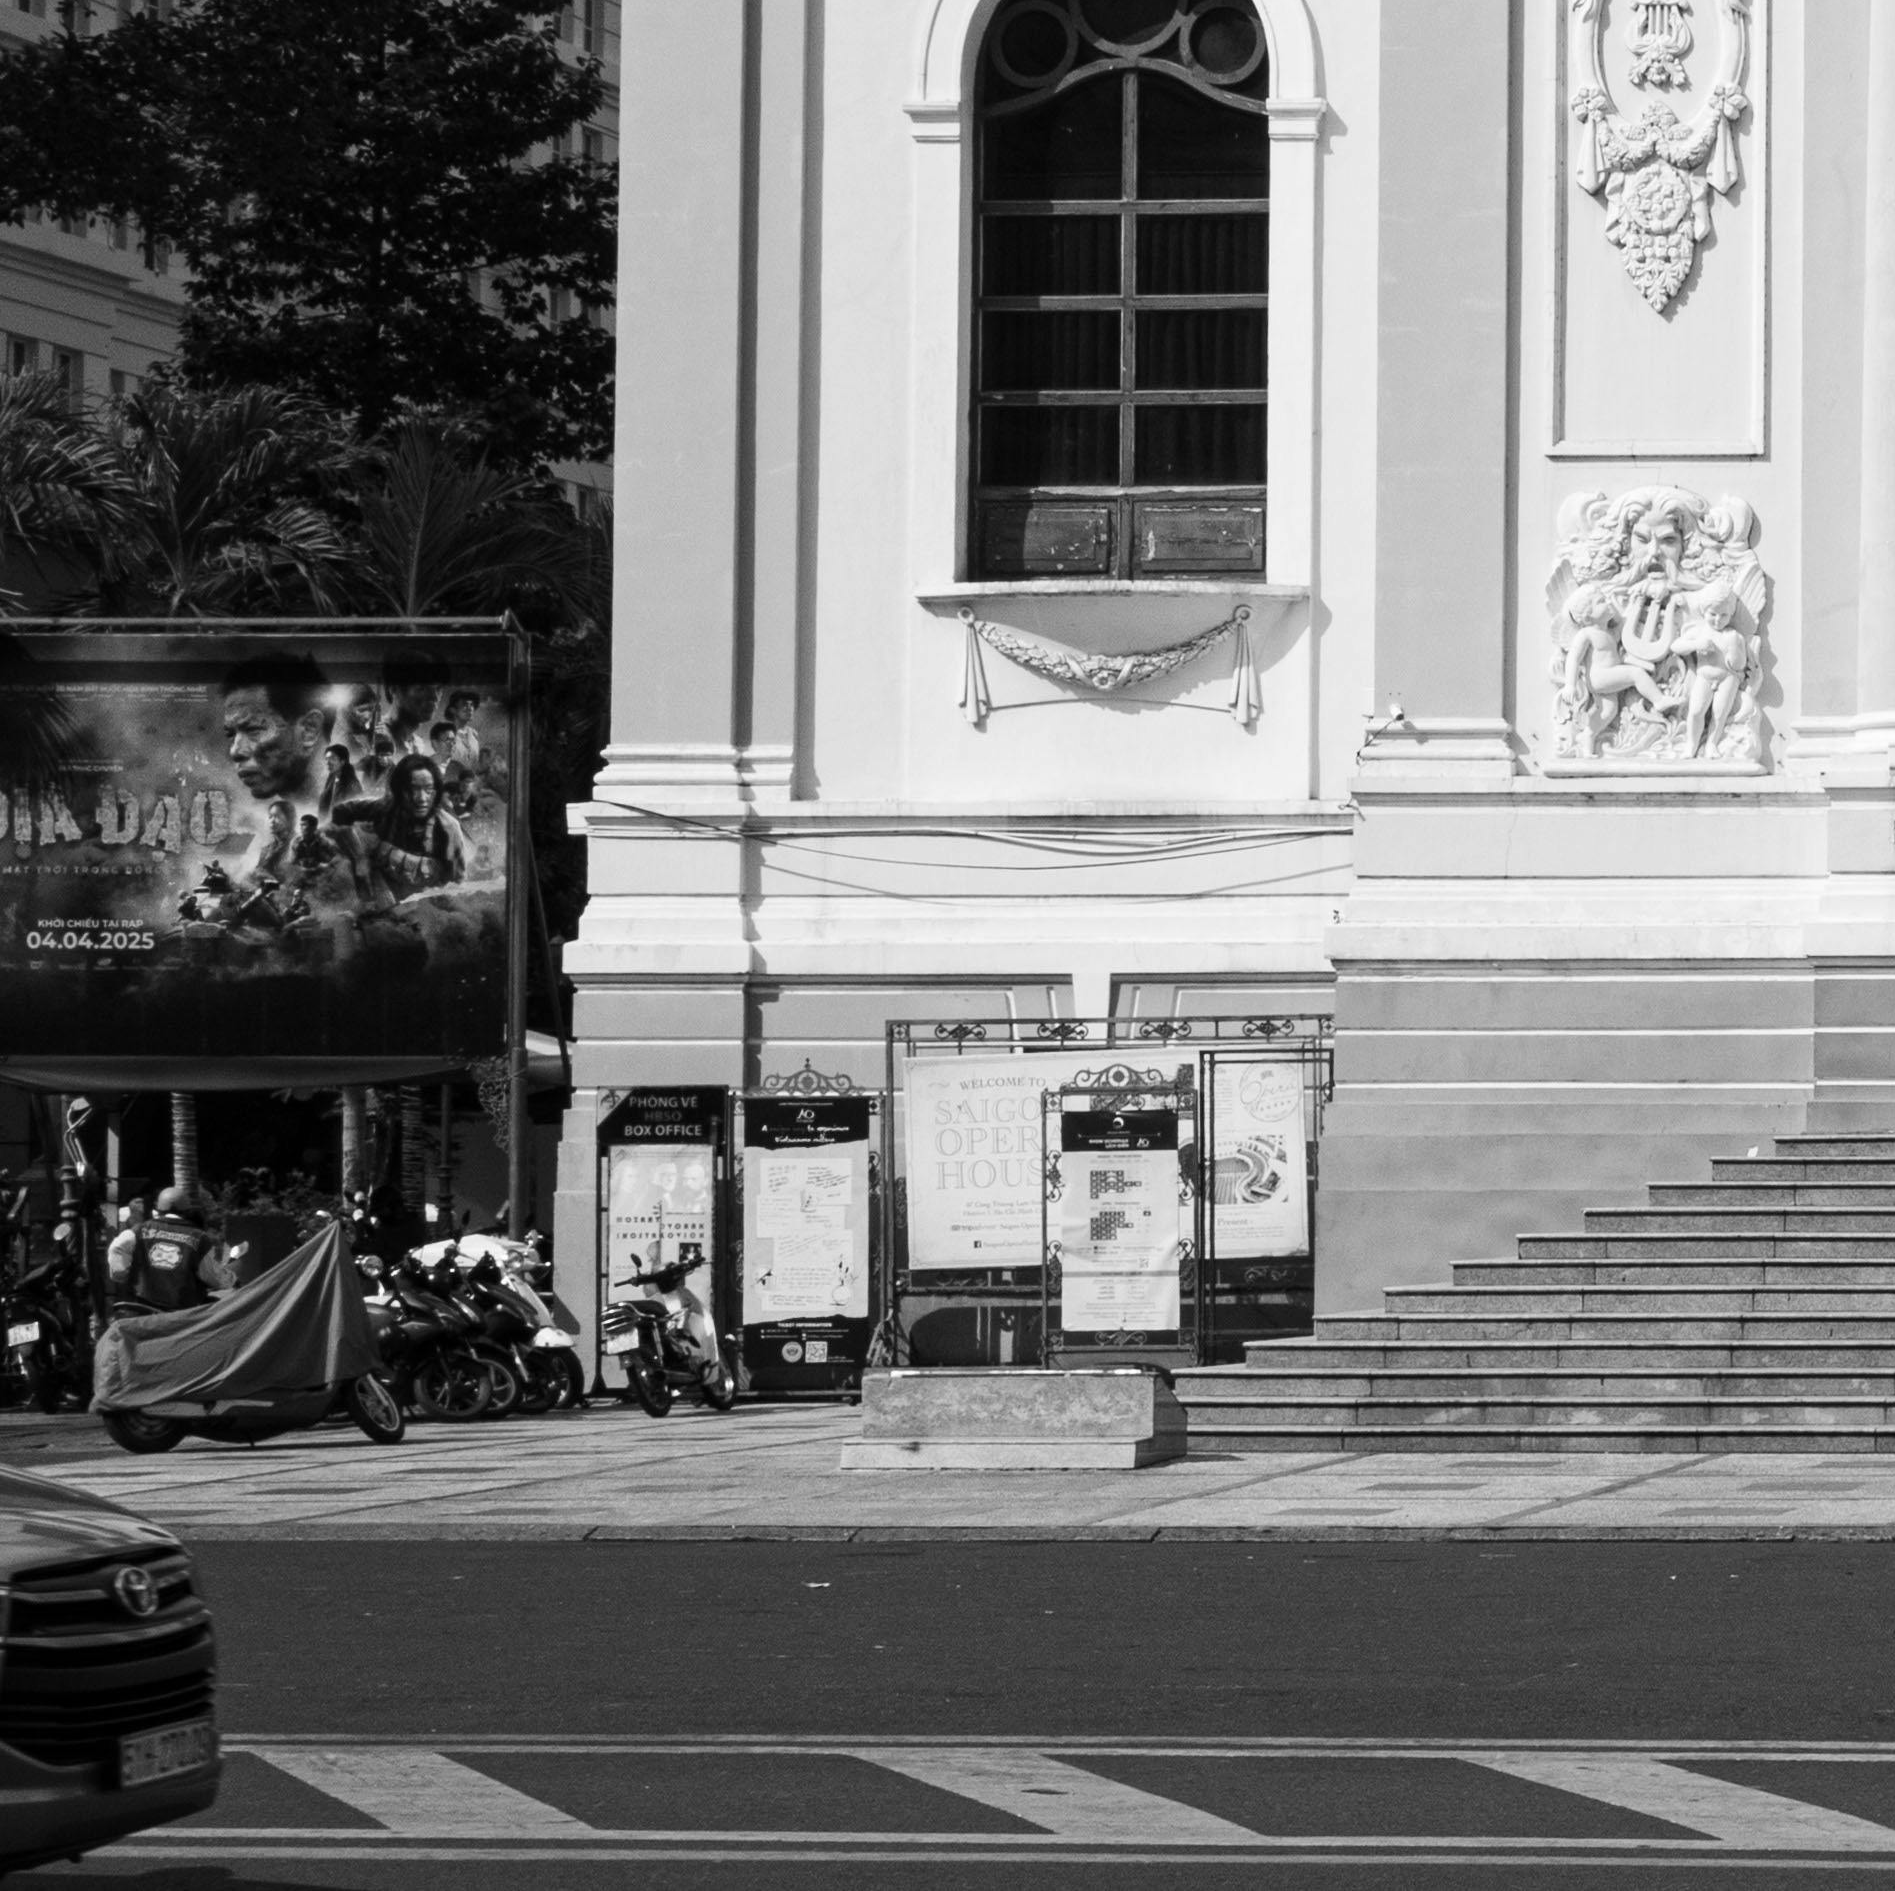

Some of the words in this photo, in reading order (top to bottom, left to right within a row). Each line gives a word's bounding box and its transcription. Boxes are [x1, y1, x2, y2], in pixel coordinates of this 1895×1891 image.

[95, 783, 231, 862] ĐẠO
[26, 931, 156, 950] 04.04.2025
[960, 1077, 1025, 1090] WELCOME
[1028, 1076, 1046, 1088] TO
[629, 1095, 679, 1108] PHÒNG
[644, 1110, 682, 1122] HBSO
[935, 1095, 1043, 1125] SAIGO
[624, 1125, 653, 1137] BOX
[655, 1125, 703, 1137] OFFICE
[936, 1156, 1042, 1190] HOUS
